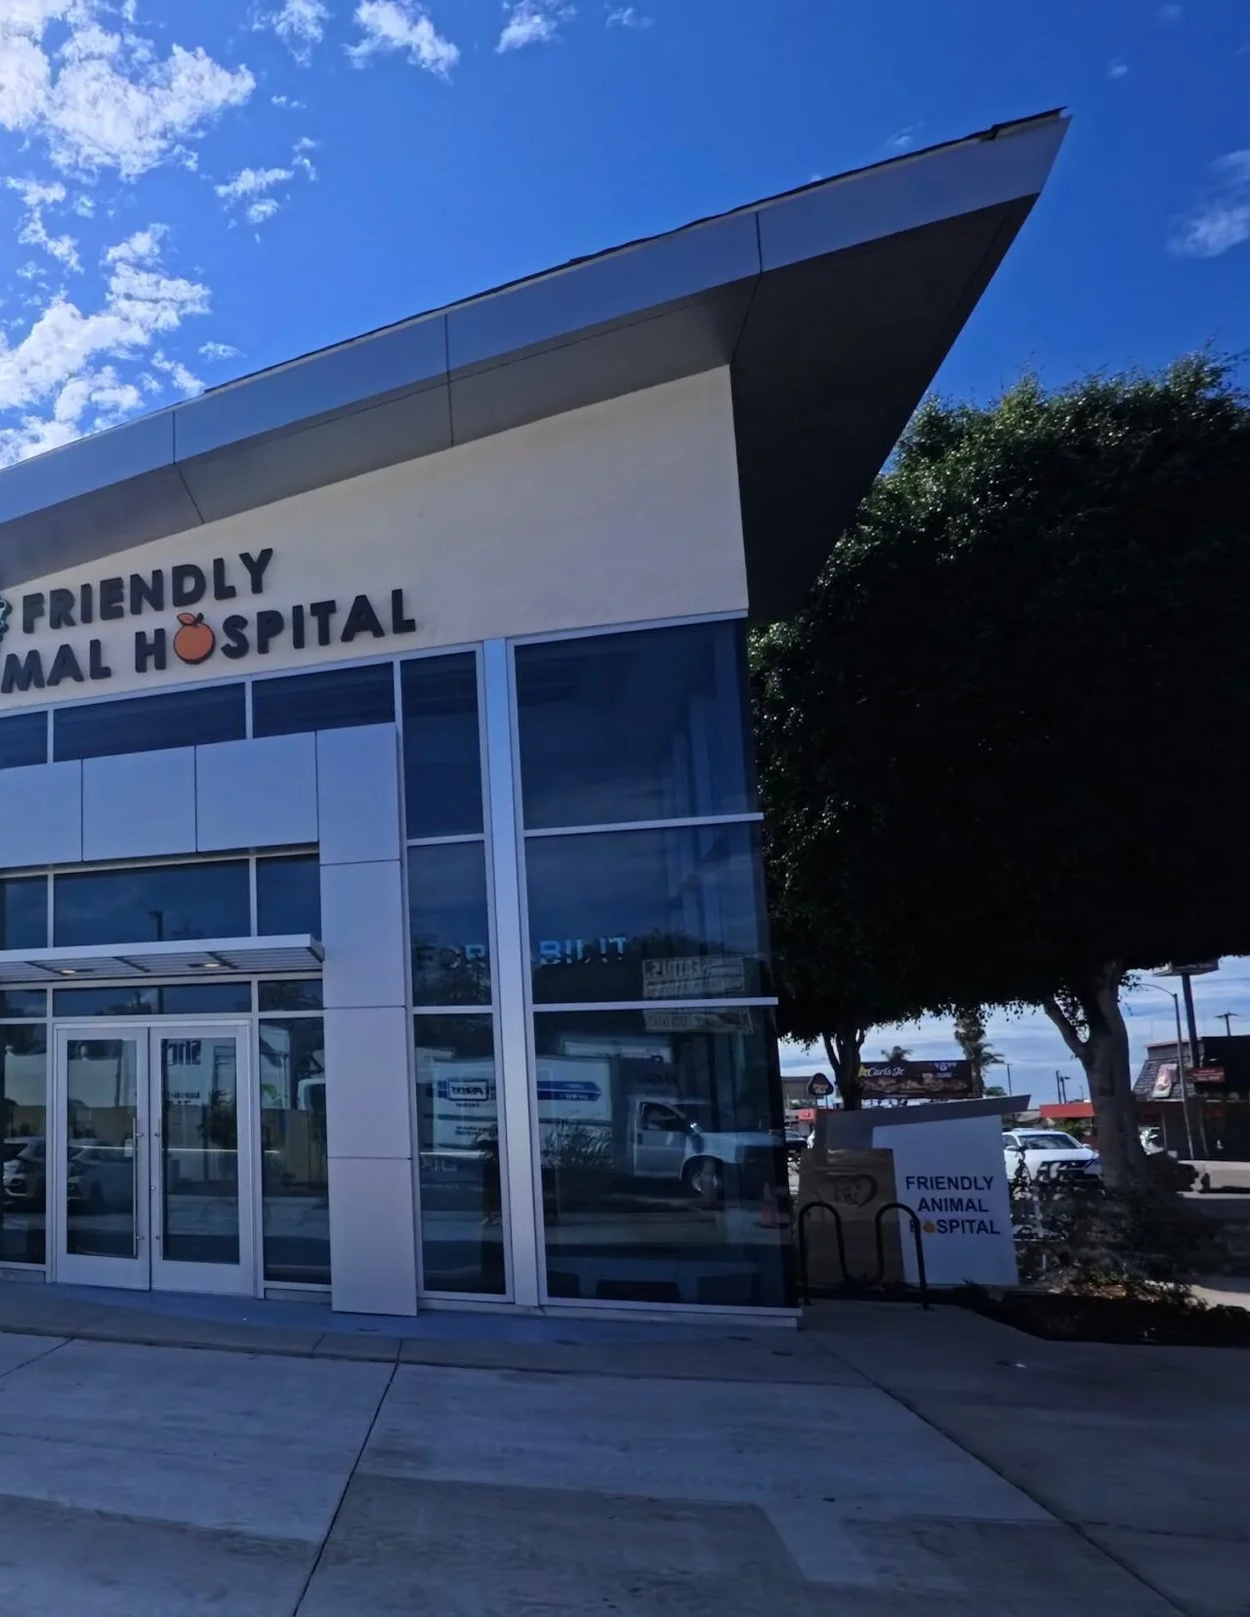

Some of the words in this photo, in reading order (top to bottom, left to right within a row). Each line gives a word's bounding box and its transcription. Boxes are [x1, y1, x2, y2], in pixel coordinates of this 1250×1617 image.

[22, 547, 274, 634] FRIENDLY
[134, 588, 417, 674] HOSPITAL
[905, 1175, 994, 1191] FRIENDLY
[917, 1197, 990, 1213] ANIMAL
